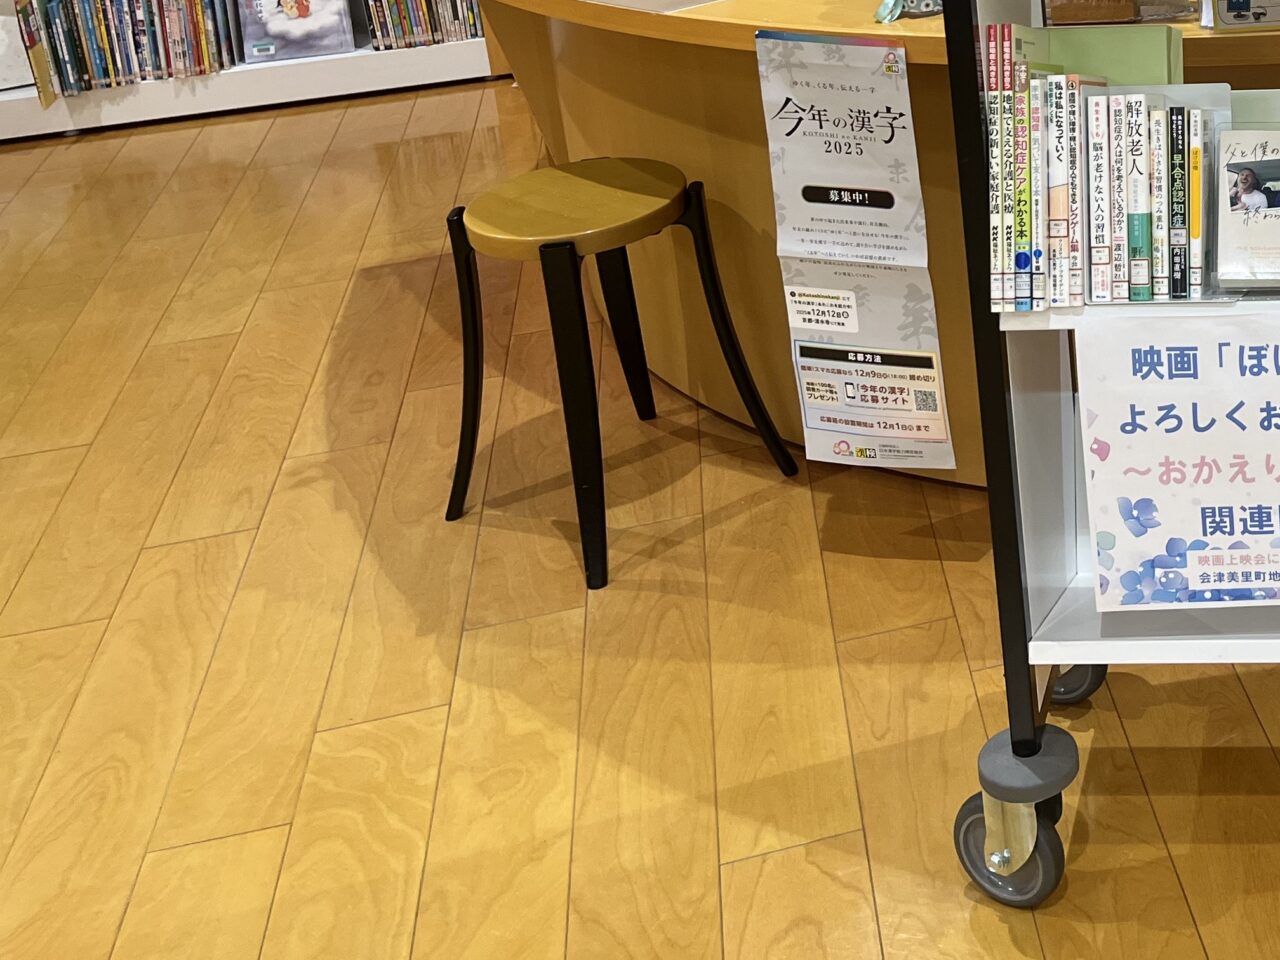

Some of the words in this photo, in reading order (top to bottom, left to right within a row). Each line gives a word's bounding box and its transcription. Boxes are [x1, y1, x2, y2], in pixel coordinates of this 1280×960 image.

[770, 97, 908, 145] 今年の漢字
[802, 130, 839, 139] KOTOSHI
[824, 140, 864, 156] 2025
[989, 94, 1001, 215] 認知症の新しい家庭介護
[1002, 93, 1014, 214] 地域で支える介護と医療
[1053, 81, 1064, 163] 私は私になっていく
[1127, 100, 1144, 176] 解放老人
[1225, 141, 1280, 168] 父と僕の
[1014, 95, 1028, 240] 家族の認知症ケアがわかる本
[1092, 142, 1106, 245] 脳が老けない人の習慣
[1171, 153, 1185, 227] 早合点認知症
[848, 352, 882, 363] 応募方法
[860, 394, 909, 405] 応募サイト
